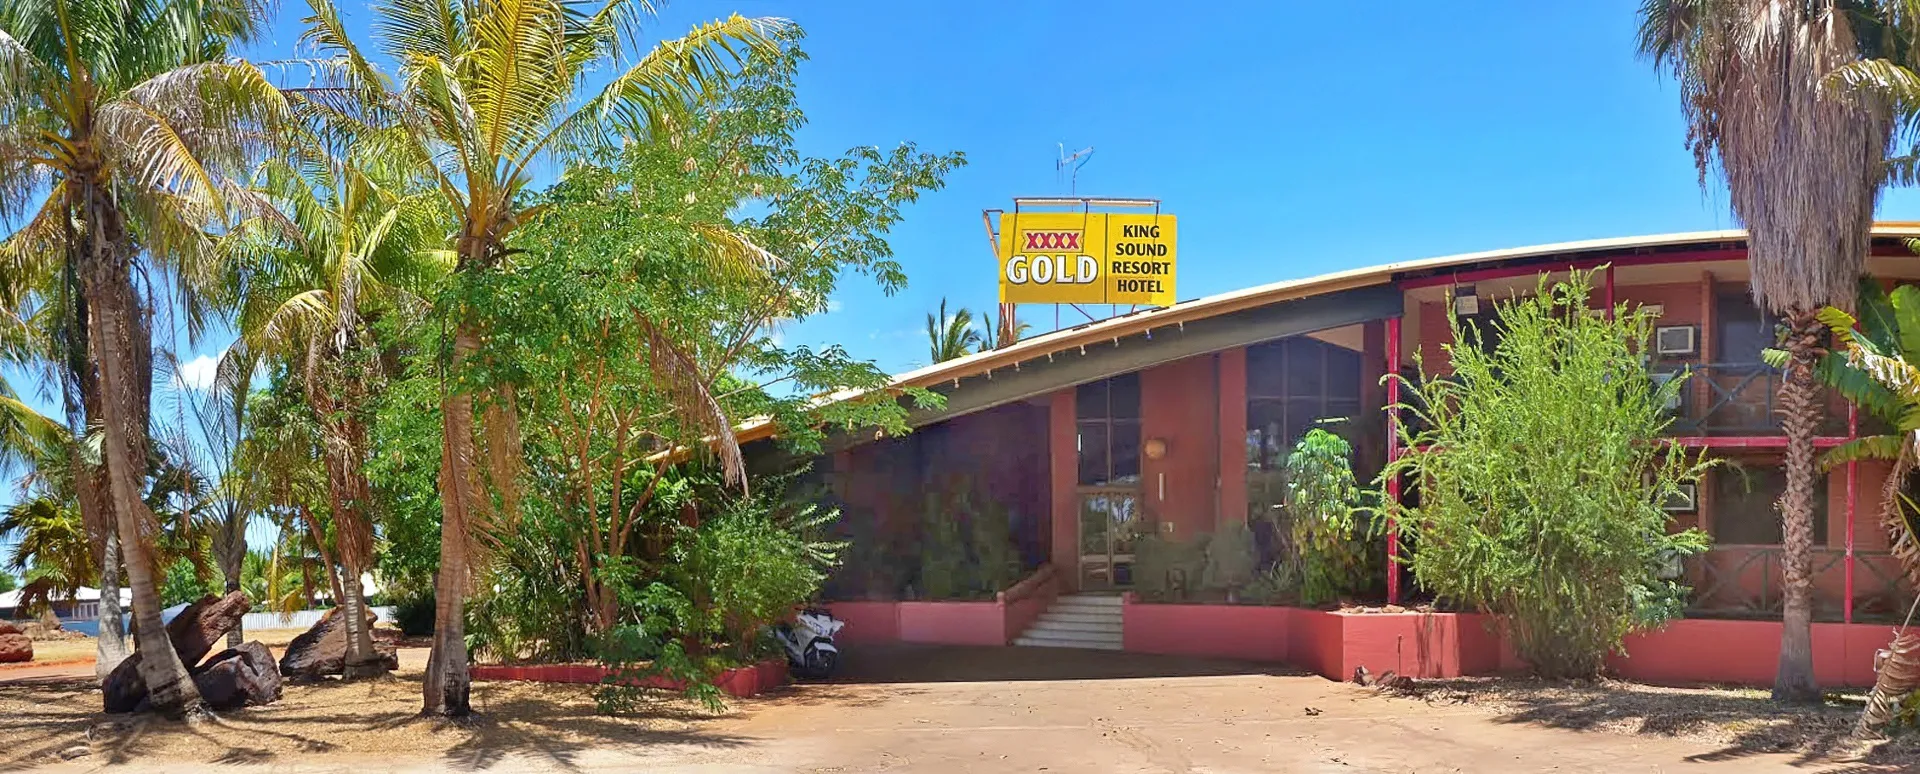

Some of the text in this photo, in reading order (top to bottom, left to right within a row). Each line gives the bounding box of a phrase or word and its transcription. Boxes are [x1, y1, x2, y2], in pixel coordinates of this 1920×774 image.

[1123, 225, 1159, 238] KING
[1026, 232, 1080, 250] XXXX
[1115, 243, 1167, 256] SOUND
[1005, 255, 1099, 285] GOLD
[1112, 262, 1171, 275] RESORT
[1117, 280, 1164, 293] HOTEL
